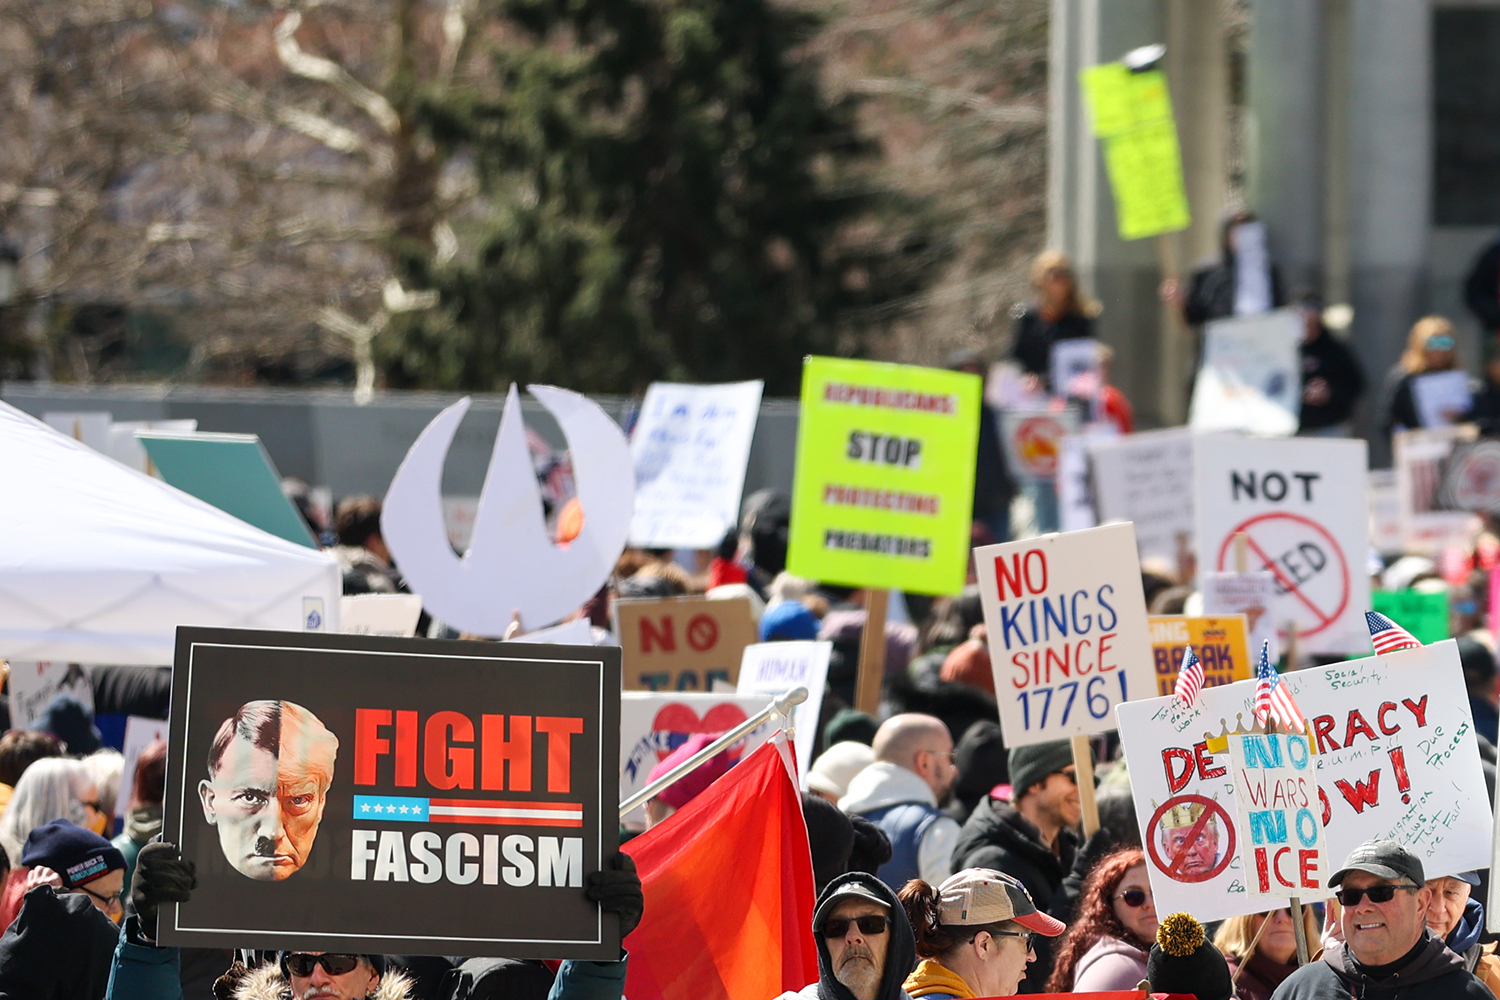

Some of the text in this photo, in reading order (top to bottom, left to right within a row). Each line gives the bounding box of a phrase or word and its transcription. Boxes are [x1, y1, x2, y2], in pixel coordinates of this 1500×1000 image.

[847, 430, 921, 467] STOP
[825, 485, 937, 516] PROTECTING
[1230, 470, 1320, 502] NOT
[825, 530, 929, 558] PREDATORS
[994, 548, 1048, 602] NO
[638, 613, 719, 653] NO
[1001, 584, 1118, 650] KINGS
[1012, 633, 1118, 689] SINCE
[1017, 669, 1128, 731] 1776!
[353, 707, 584, 793] FIGHT
[1161, 695, 1428, 795] DERACY
[1241, 734, 1310, 771] NO
[1417, 726, 1445, 756] Due
[1242, 768, 1309, 810] WARS
[1248, 807, 1318, 848] NO
[350, 829, 584, 888] FASCISM
[1254, 845, 1320, 894] ICE
